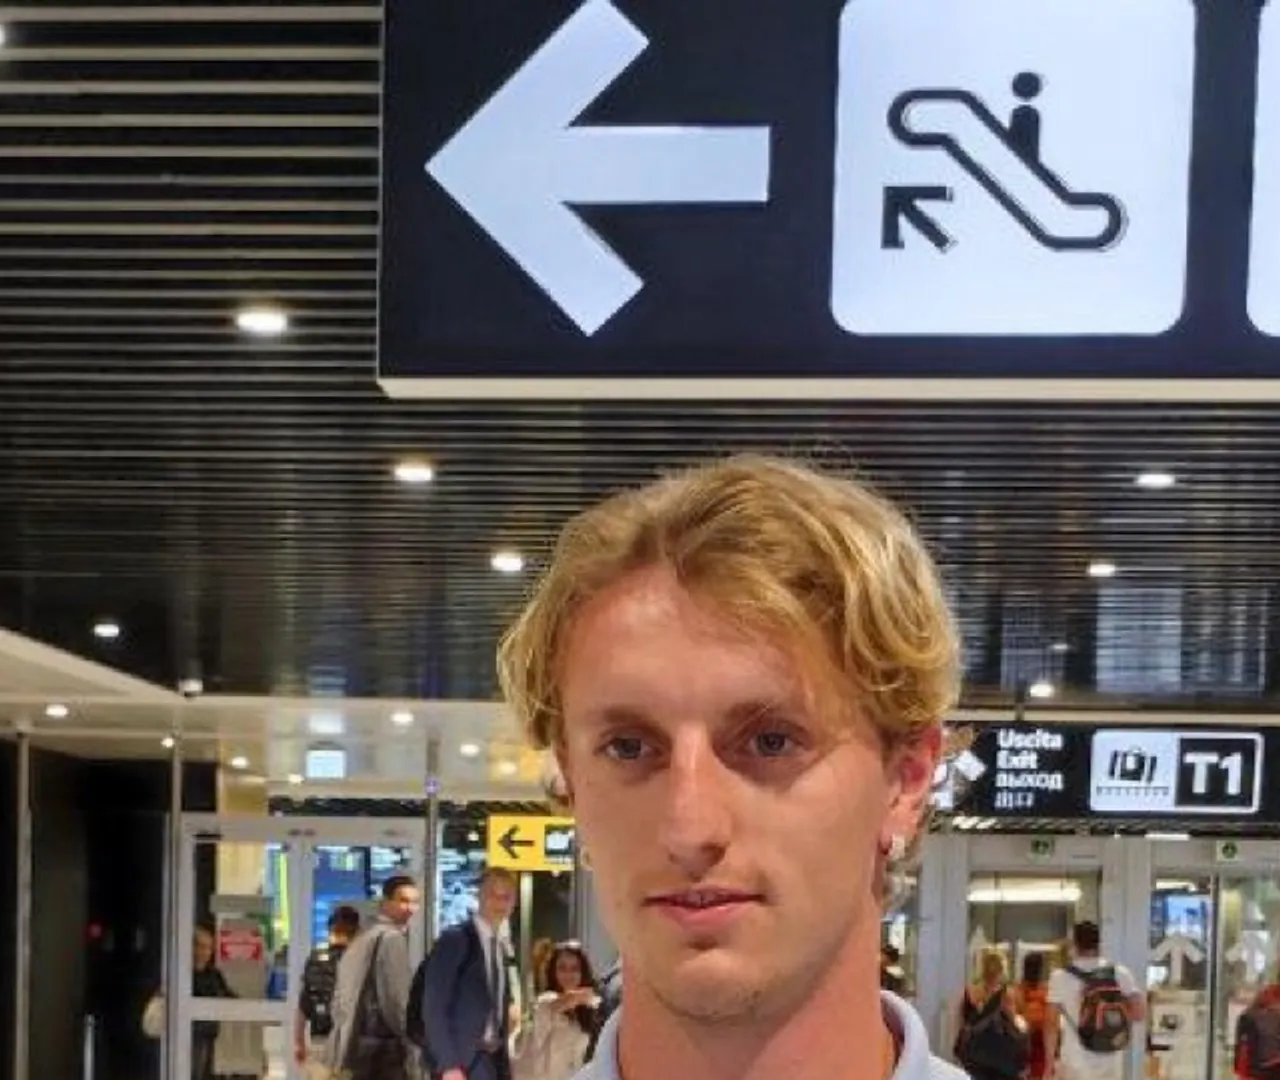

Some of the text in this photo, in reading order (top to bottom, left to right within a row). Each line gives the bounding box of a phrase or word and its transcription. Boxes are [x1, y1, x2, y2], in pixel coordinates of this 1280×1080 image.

[997, 728, 1062, 749] Uscita
[996, 750, 1038, 769] Exit
[1183, 752, 1241, 794] T1
